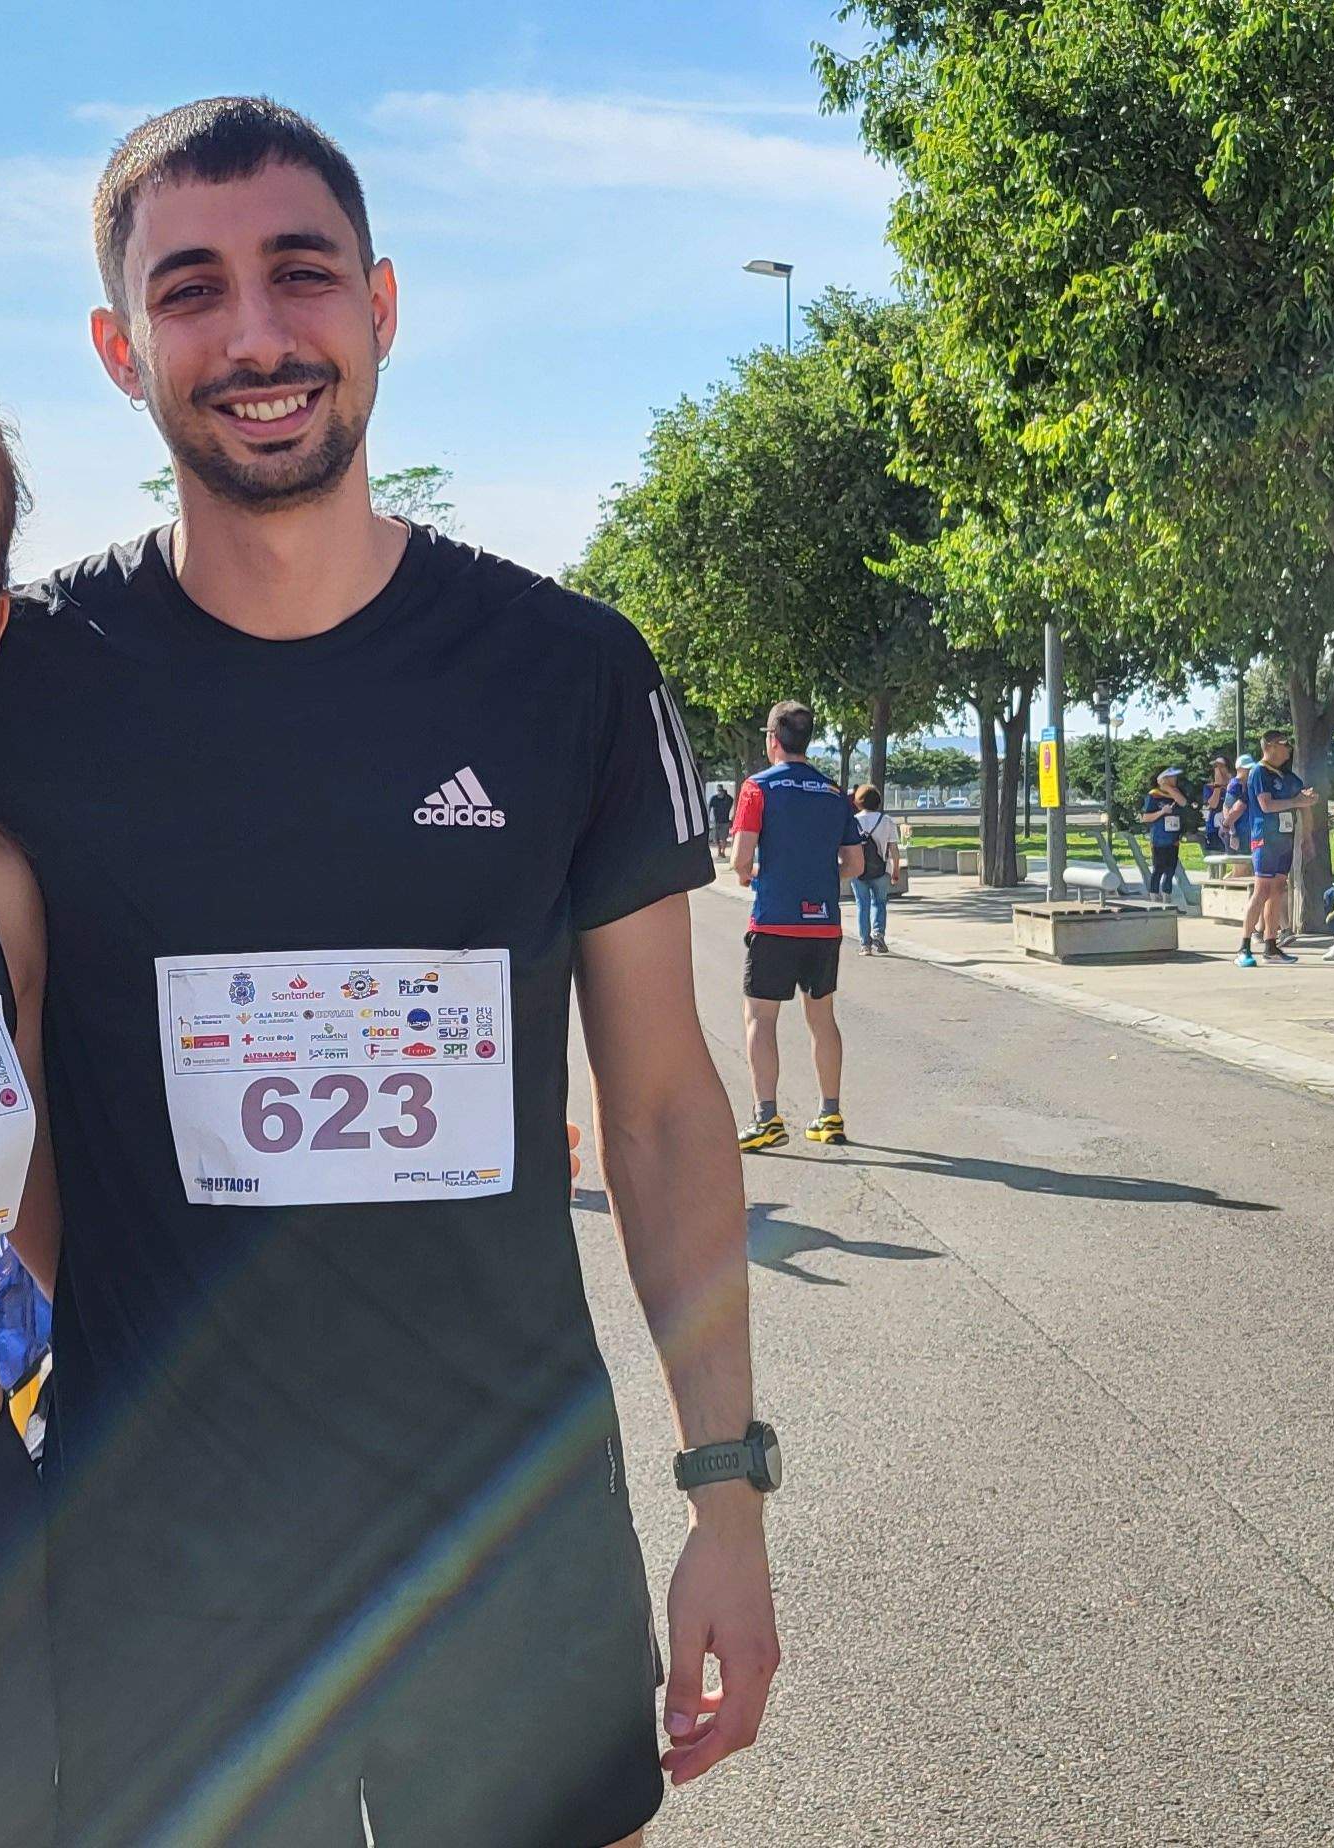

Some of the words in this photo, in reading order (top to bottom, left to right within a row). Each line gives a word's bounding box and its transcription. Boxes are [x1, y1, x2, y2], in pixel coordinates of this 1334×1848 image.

[769, 779, 828, 789] POLICIA
[414, 803, 506, 827] adidas
[272, 990, 325, 1001] Santander
[438, 1007, 468, 1015] CEP
[361, 1025, 399, 1037] eboca
[240, 1072, 438, 1154] 623
[394, 1170, 480, 1184] POLICIA
